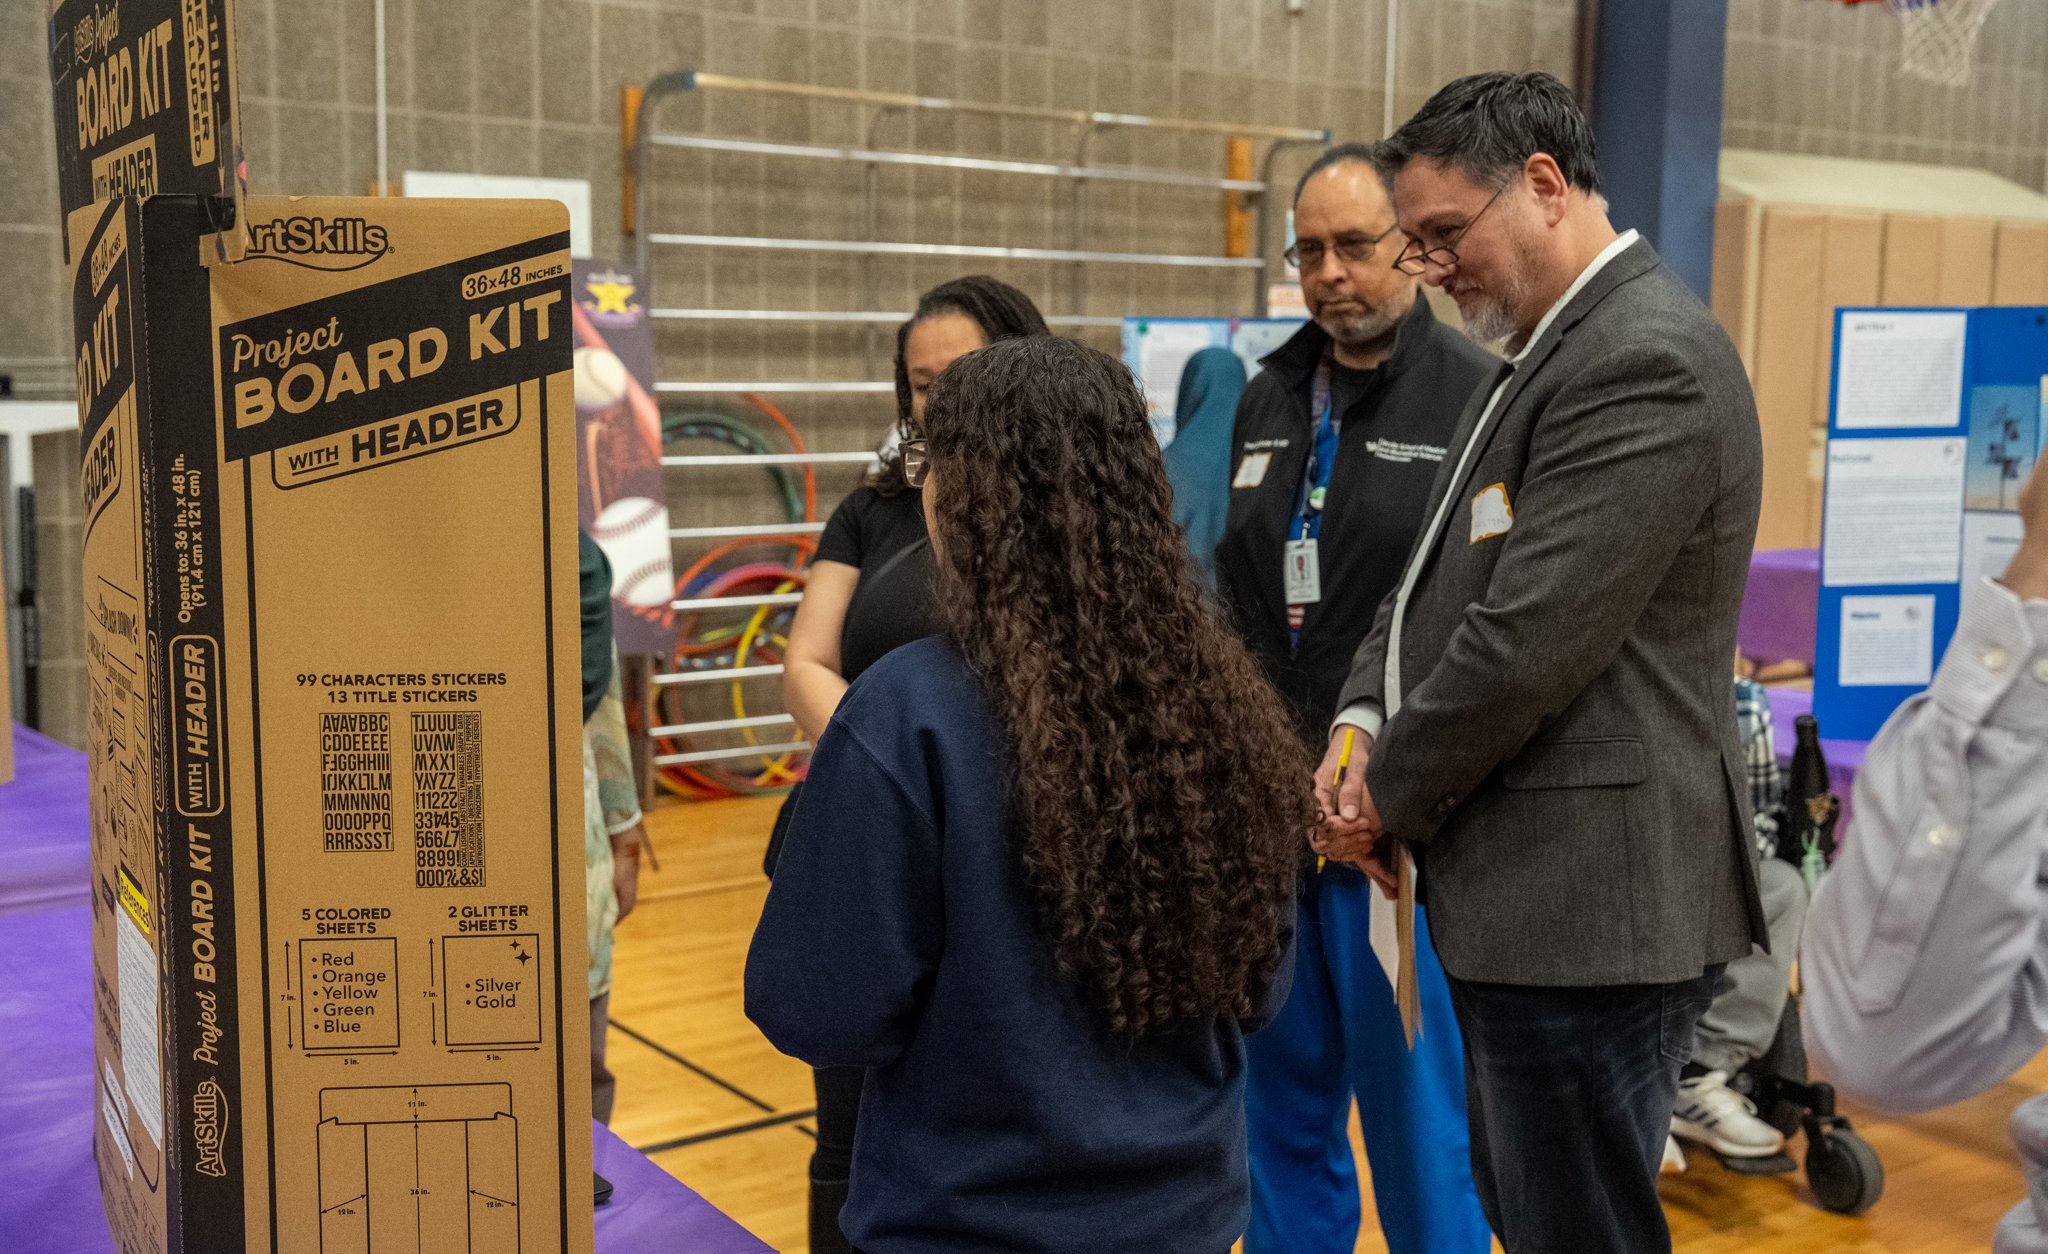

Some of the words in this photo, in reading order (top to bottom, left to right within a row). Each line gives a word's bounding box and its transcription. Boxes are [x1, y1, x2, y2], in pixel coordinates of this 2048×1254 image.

[95, 0, 119, 56] Project
[76, 46, 133, 150] BOARD
[138, 18, 172, 120] KIT
[108, 147, 155, 200] HEADER
[465, 266, 522, 300] 36x48
[525, 264, 563, 282] INCHES
[93, 283, 119, 397] KIT
[231, 316, 344, 373] Project
[234, 327, 449, 430] BOARD
[469, 290, 562, 361] KIT
[288, 445, 339, 471] WITH
[352, 398, 504, 463] HEADER
[171, 453, 185, 472] in.
[172, 474, 185, 494] 48
[186, 470, 201, 497] cm)
[176, 497, 186, 507] x
[174, 509, 187, 527] in.
[187, 502, 202, 529] 121
[174, 530, 189, 550] 36
[192, 531, 202, 542] x
[177, 553, 189, 574] to:
[192, 544, 203, 566] cm
[190, 568, 207, 607] (91.4
[178, 575, 195, 623] Opens
[297, 674, 317, 686] 99
[321, 673, 426, 686] CHARACTERS
[431, 673, 507, 685] STICKERS
[150, 640, 161, 754] HEADER
[184, 644, 208, 757] HEADER
[328, 690, 347, 703] 13
[353, 690, 397, 703] TITLE
[402, 690, 478, 702] STICKERS
[322, 733, 388, 752] CDDEEEE
[188, 763, 203, 808] WITH
[189, 824, 211, 874] KIT
[326, 832, 391, 850] RRRSSST
[121, 875, 150, 932] References
[448, 906, 457, 918] 2
[461, 905, 529, 917] GLITTER
[302, 909, 311, 920] 5
[315, 908, 391, 920] COLORED
[191, 878, 216, 984] BOARD
[316, 922, 376, 934] SHEETS
[458, 919, 518, 932] SHEETS
[322, 952, 354, 966] Red
[322, 970, 386, 985] Orange
[475, 978, 521, 992] Silver
[322, 985, 378, 999] Yellow
[430, 990, 438, 998] in.
[475, 994, 516, 1008] Gold
[323, 1003, 374, 1017] Green
[193, 990, 224, 1065] Project
[324, 1019, 361, 1033] Blue
[195, 1080, 218, 1177] ArtSkills
